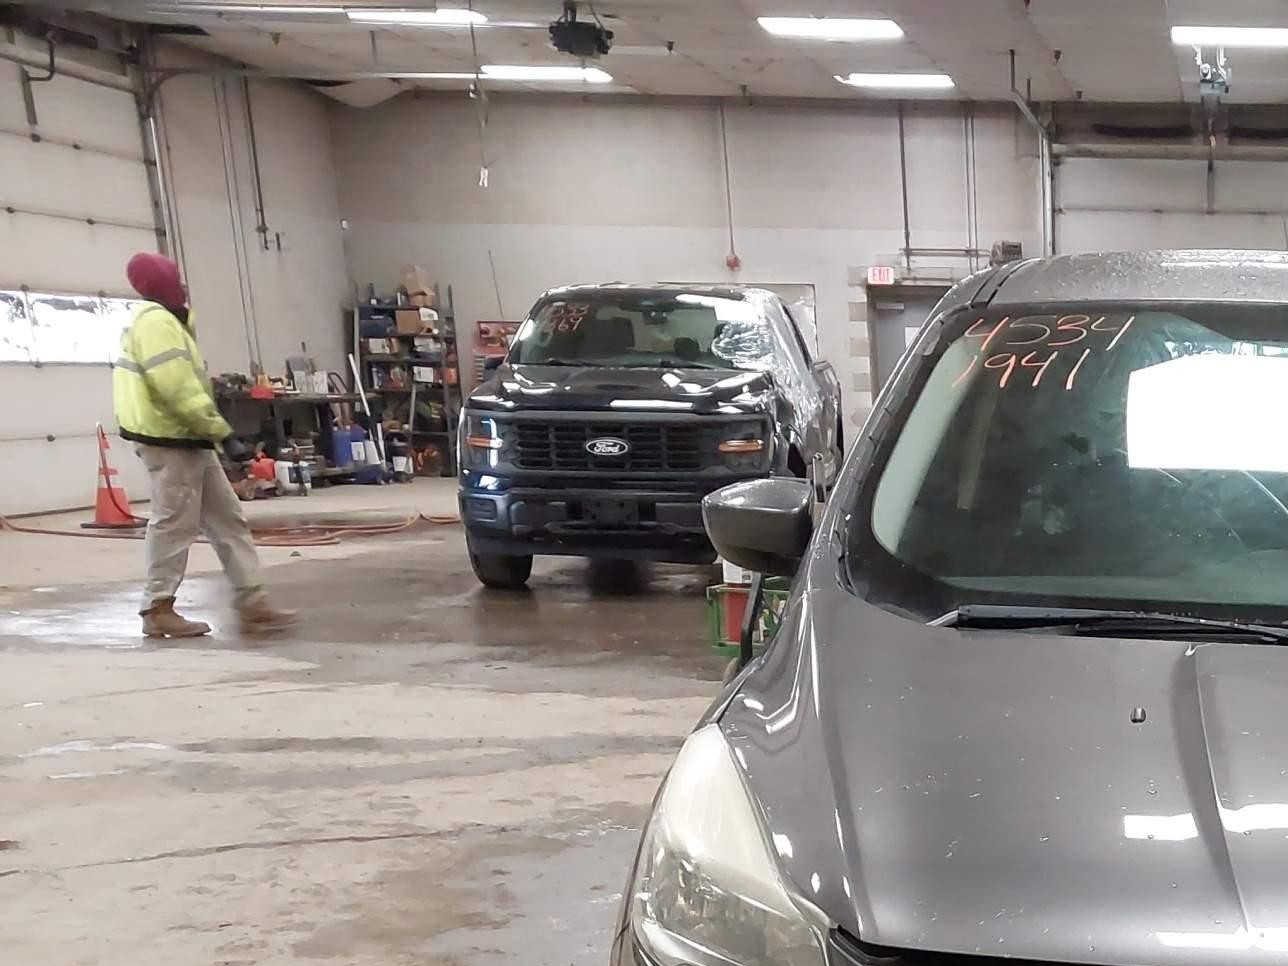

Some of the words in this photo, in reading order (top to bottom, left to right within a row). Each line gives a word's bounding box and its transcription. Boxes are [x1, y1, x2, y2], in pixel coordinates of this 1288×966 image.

[964, 314, 1136, 352] 4534
[951, 348, 1091, 390] 1941
[593, 441, 620, 453] Ford
